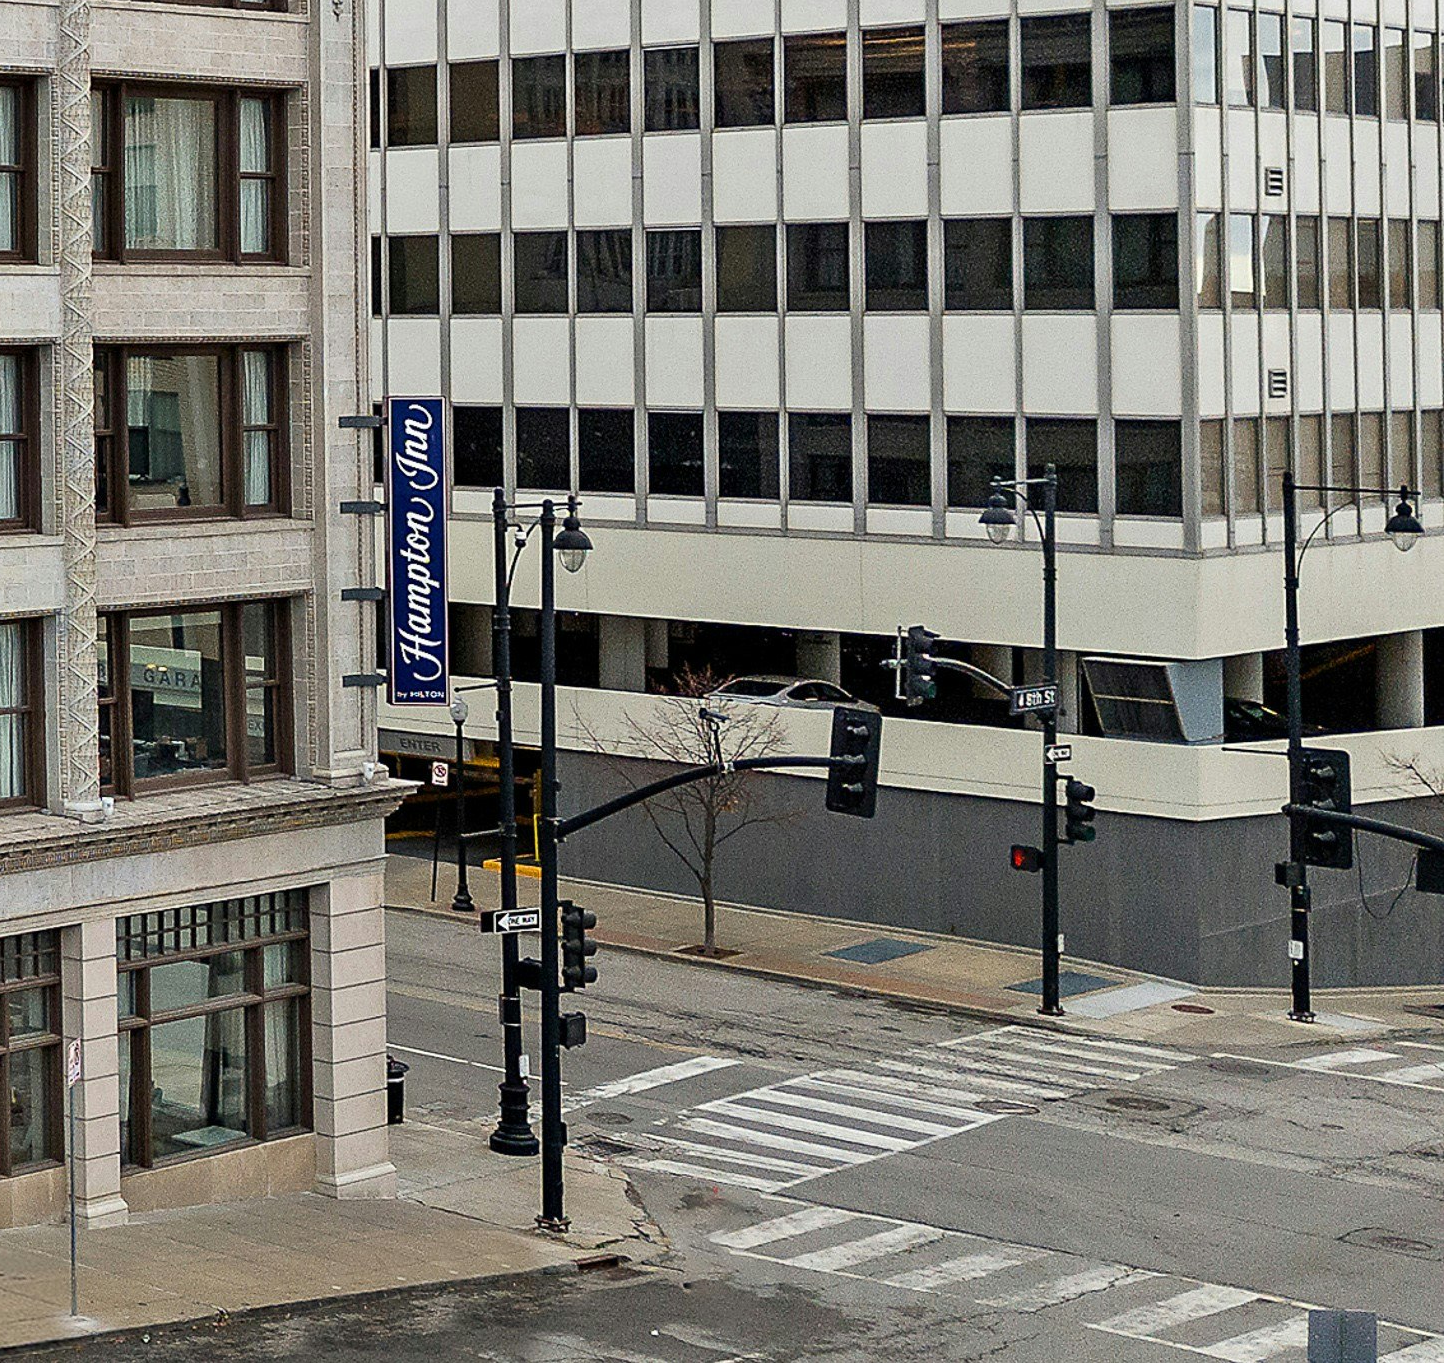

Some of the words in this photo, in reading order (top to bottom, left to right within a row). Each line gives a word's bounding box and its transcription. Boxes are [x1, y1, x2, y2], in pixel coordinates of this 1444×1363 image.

[395, 403, 439, 491] Inn
[397, 496, 442, 682] Hampton
[409, 690, 445, 699] HILTON
[399, 737, 442, 752] ENTER
